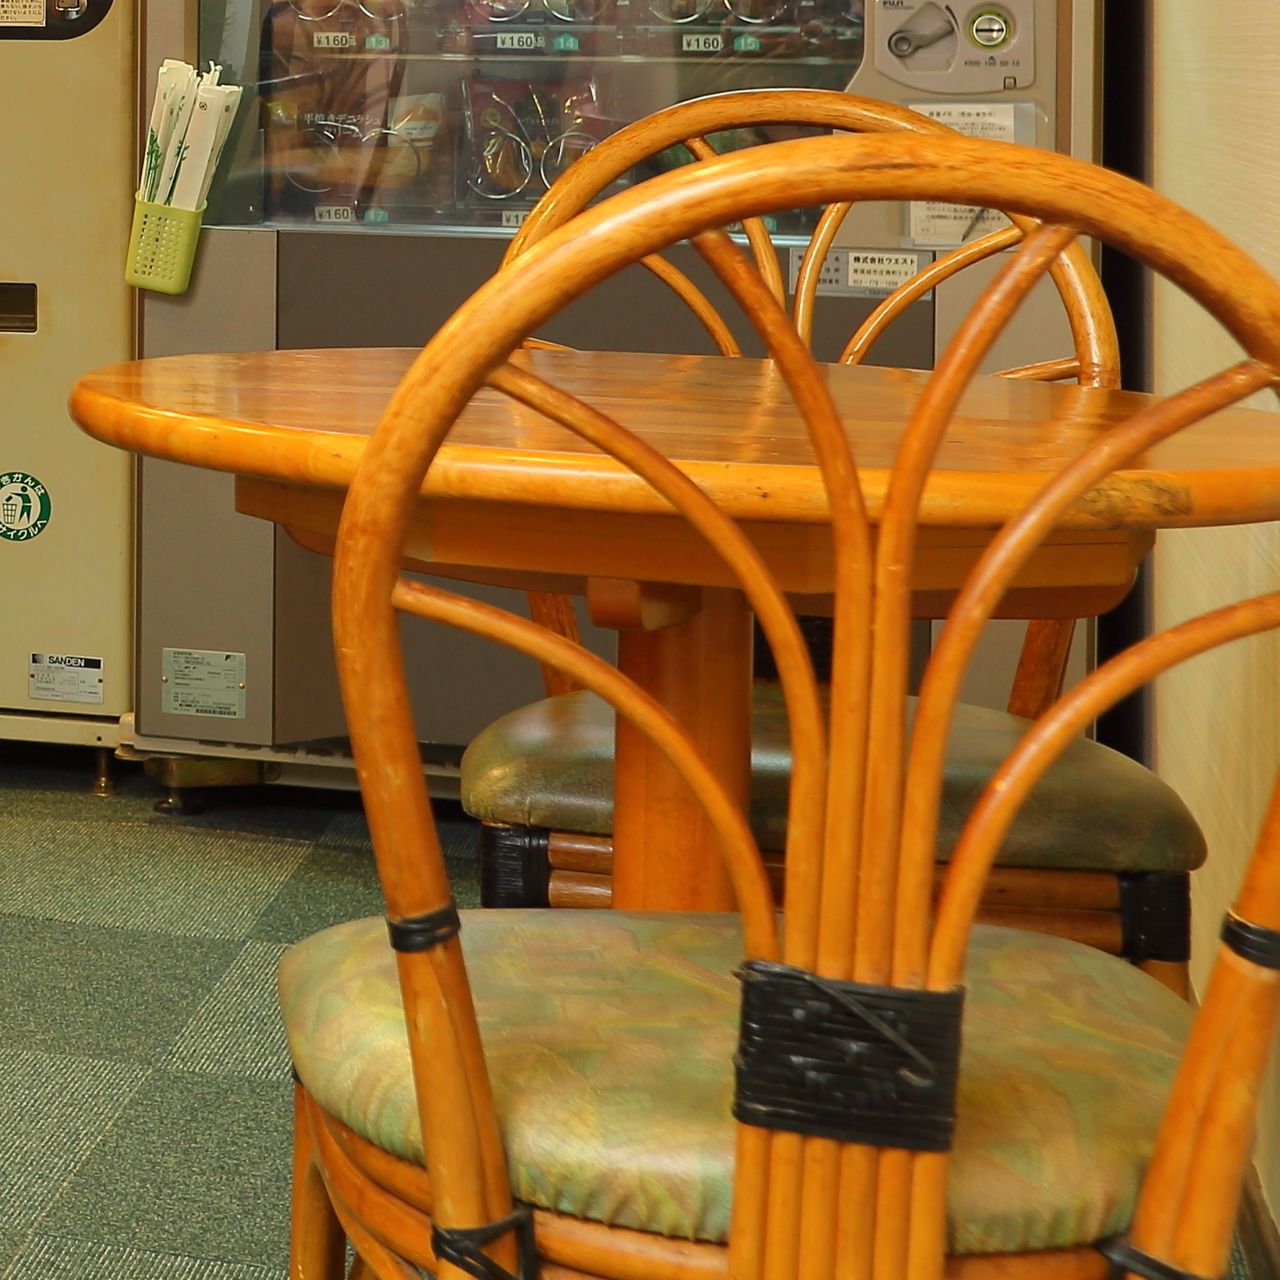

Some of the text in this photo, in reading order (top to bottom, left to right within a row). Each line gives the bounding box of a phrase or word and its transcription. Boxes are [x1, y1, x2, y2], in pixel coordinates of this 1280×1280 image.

[317, 35, 348, 47] ¥160
[500, 36, 534, 47] ¥160
[558, 37, 574, 49] 14
[685, 37, 720, 49] ¥160
[739, 37, 756, 49] 15
[317, 208, 349, 220] ¥160
[853, 255, 916, 266] 株式会社ウエスト
[48, 655, 85, 667] SANDEN
